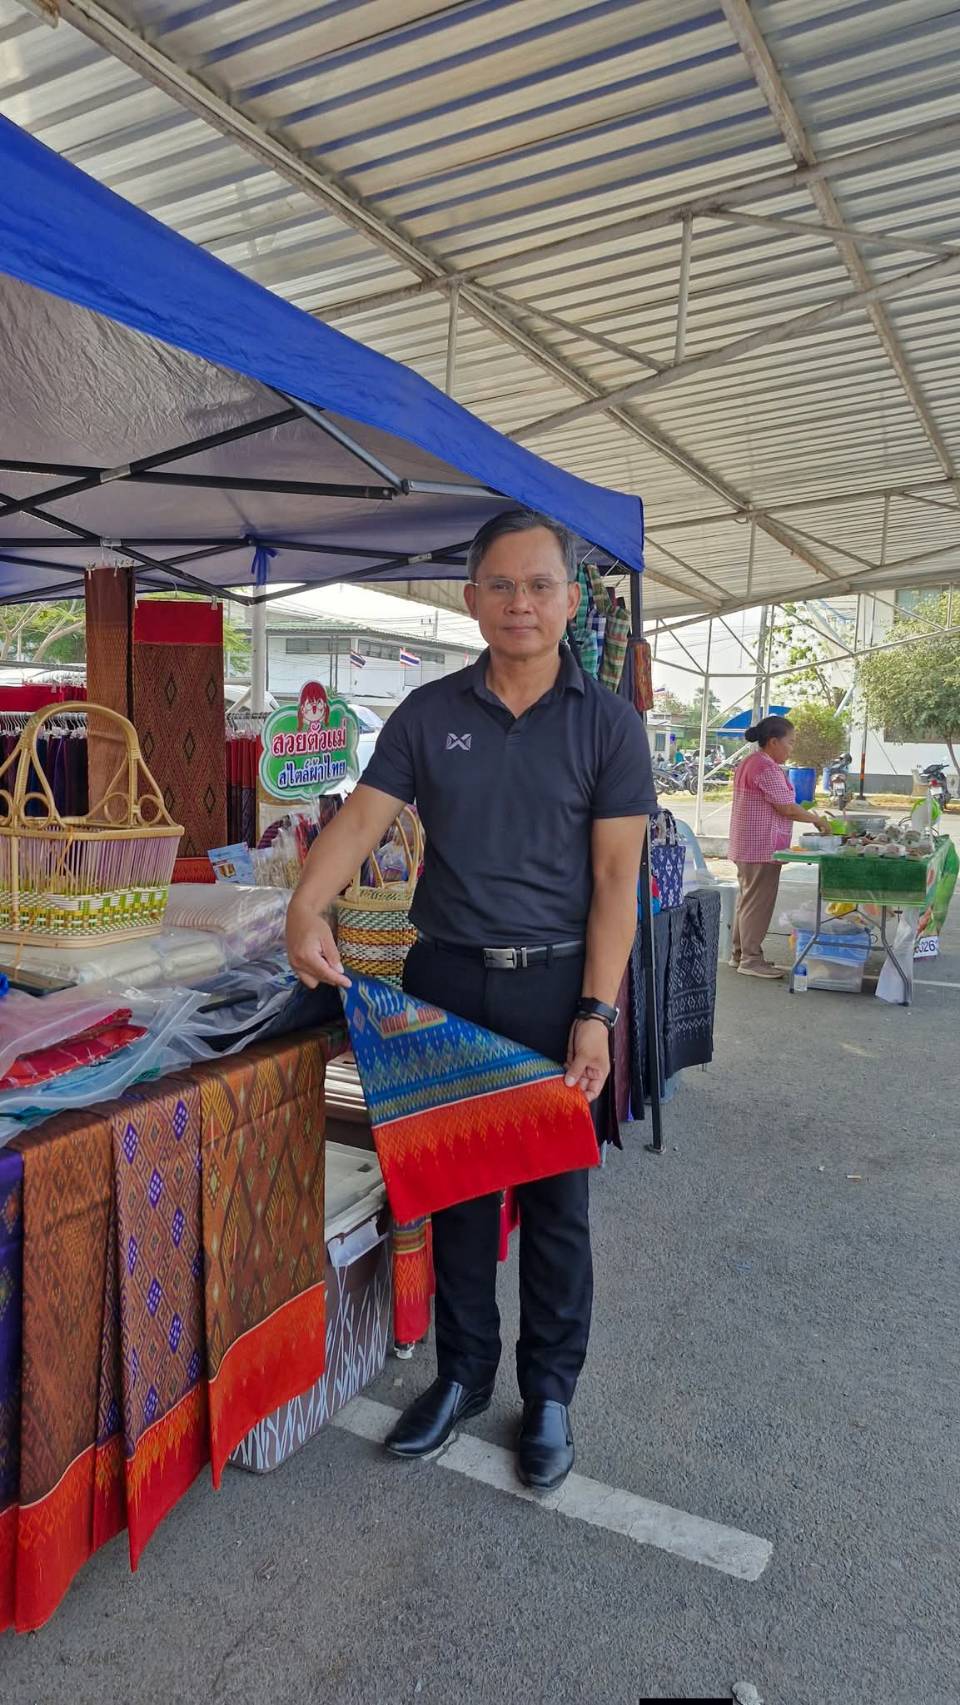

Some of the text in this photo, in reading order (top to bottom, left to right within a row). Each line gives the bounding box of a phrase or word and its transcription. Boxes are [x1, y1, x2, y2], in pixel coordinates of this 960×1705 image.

[273, 719, 346, 754] สวยตัวแม่
[279, 754, 346, 786] สไตล์ผ้าไทย
